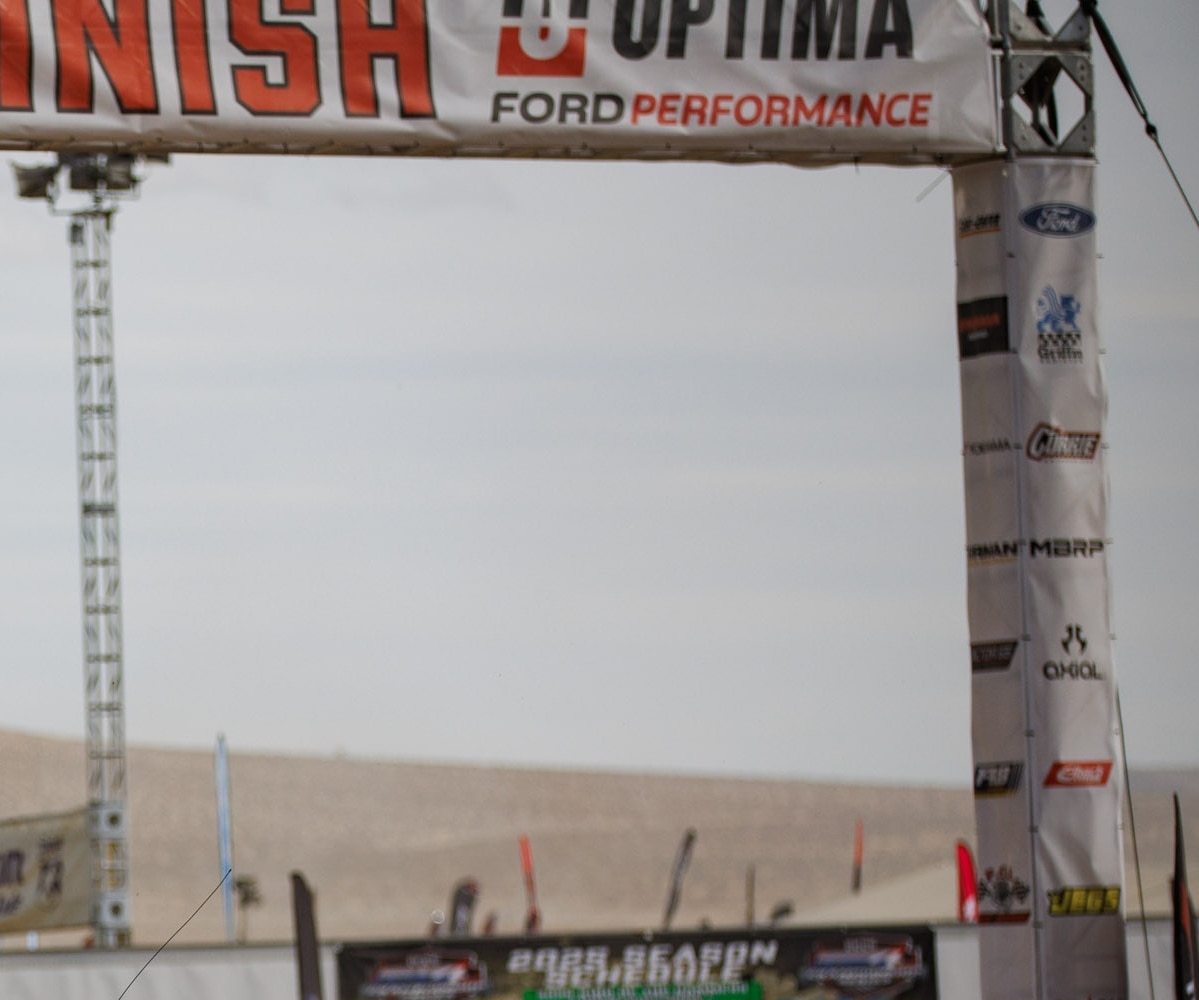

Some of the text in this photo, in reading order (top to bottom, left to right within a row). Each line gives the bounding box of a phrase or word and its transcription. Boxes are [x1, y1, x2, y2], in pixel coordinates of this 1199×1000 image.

[490, 92, 934, 127] FORD PERFORMANCE
[1036, 206, 1081, 232] Ford
[1030, 538, 1104, 558] MBRP
[507, 949, 609, 973] 2025
[623, 939, 779, 969] SEASON
